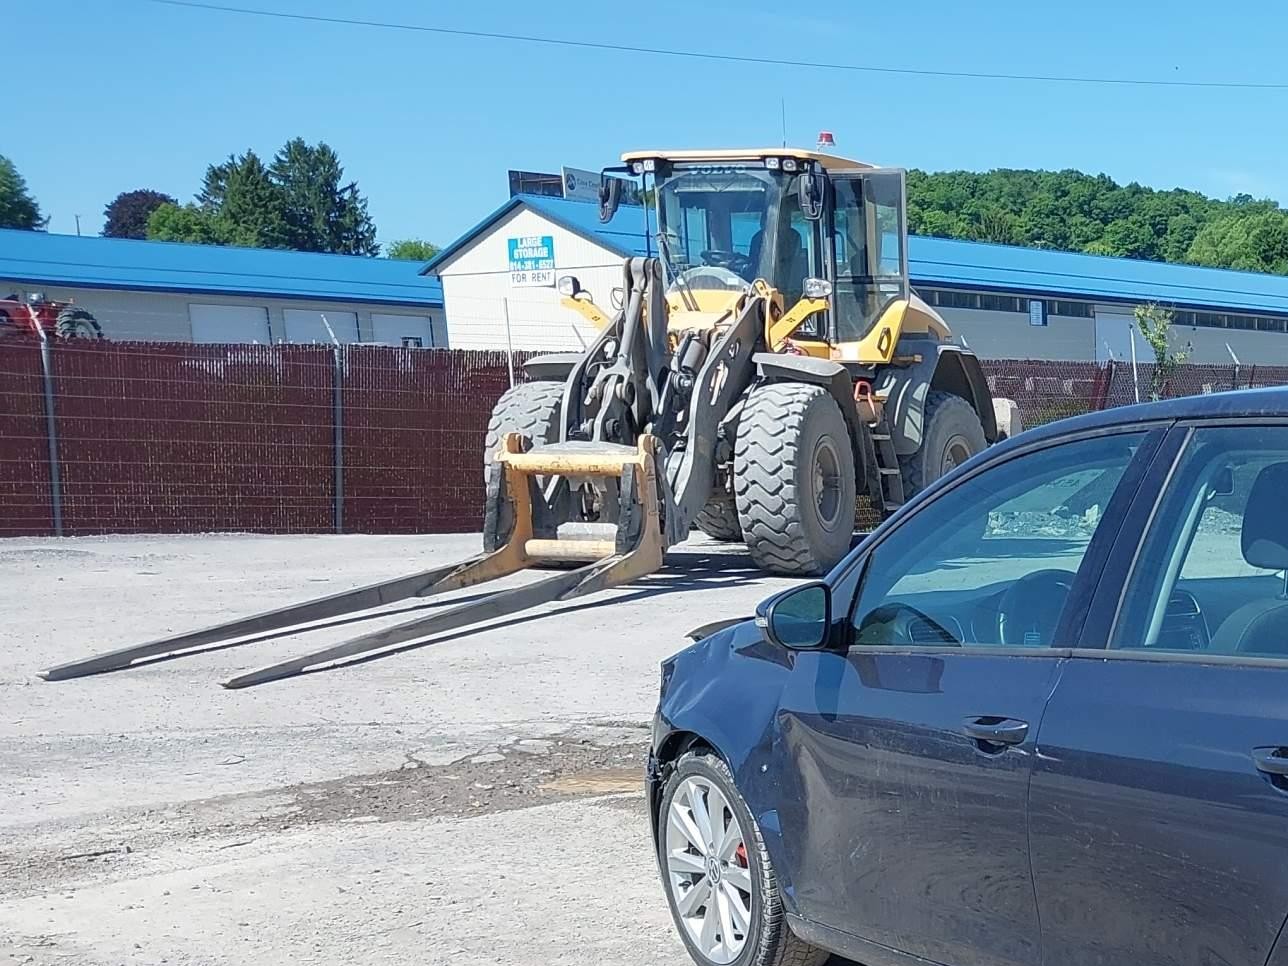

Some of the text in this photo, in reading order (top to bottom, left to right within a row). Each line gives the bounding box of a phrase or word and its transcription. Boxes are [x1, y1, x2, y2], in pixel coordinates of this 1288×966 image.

[513, 247, 548, 259] STORAGE
[511, 271, 551, 283] FOR RENT
